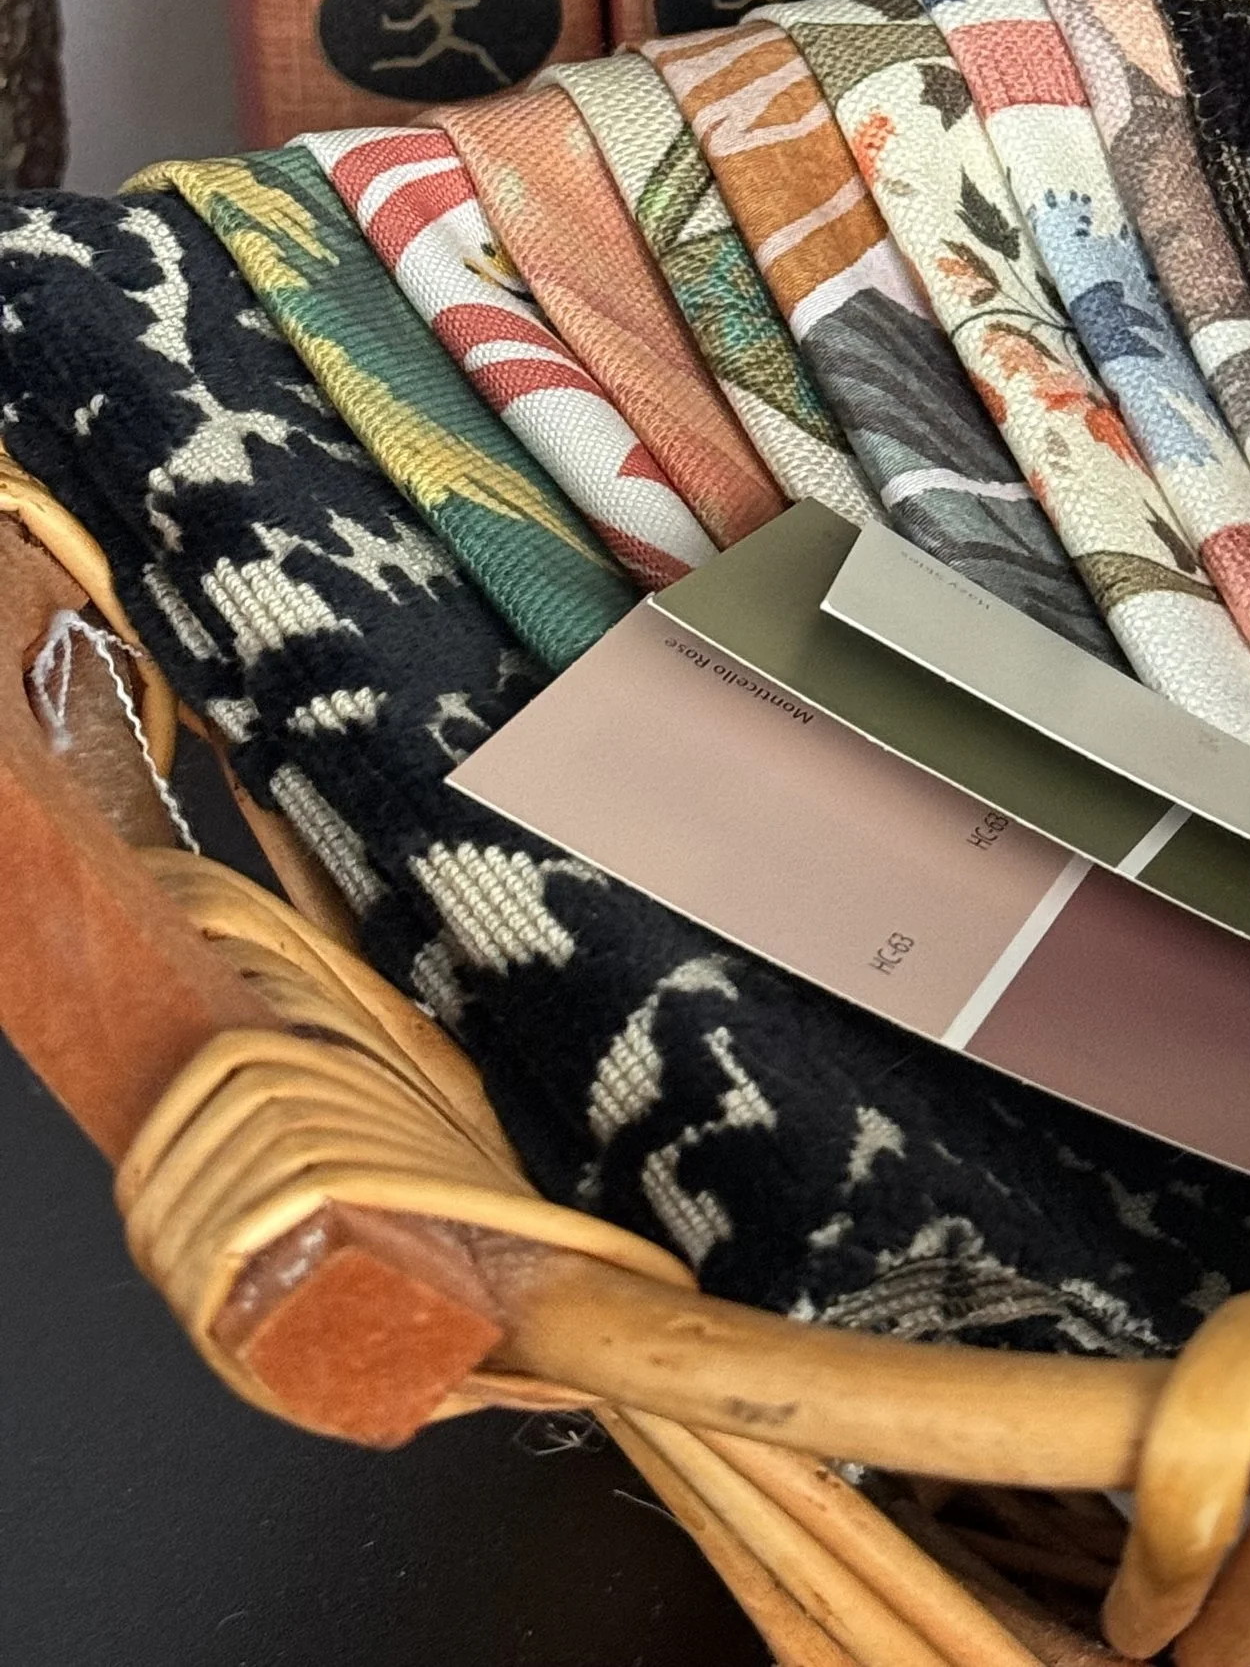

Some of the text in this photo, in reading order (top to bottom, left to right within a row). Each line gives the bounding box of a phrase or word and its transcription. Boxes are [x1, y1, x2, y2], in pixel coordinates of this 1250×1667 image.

[664, 637, 814, 724] Monticello Rose
[966, 811, 1009, 851] HC-63
[867, 931, 915, 976] HC-63
